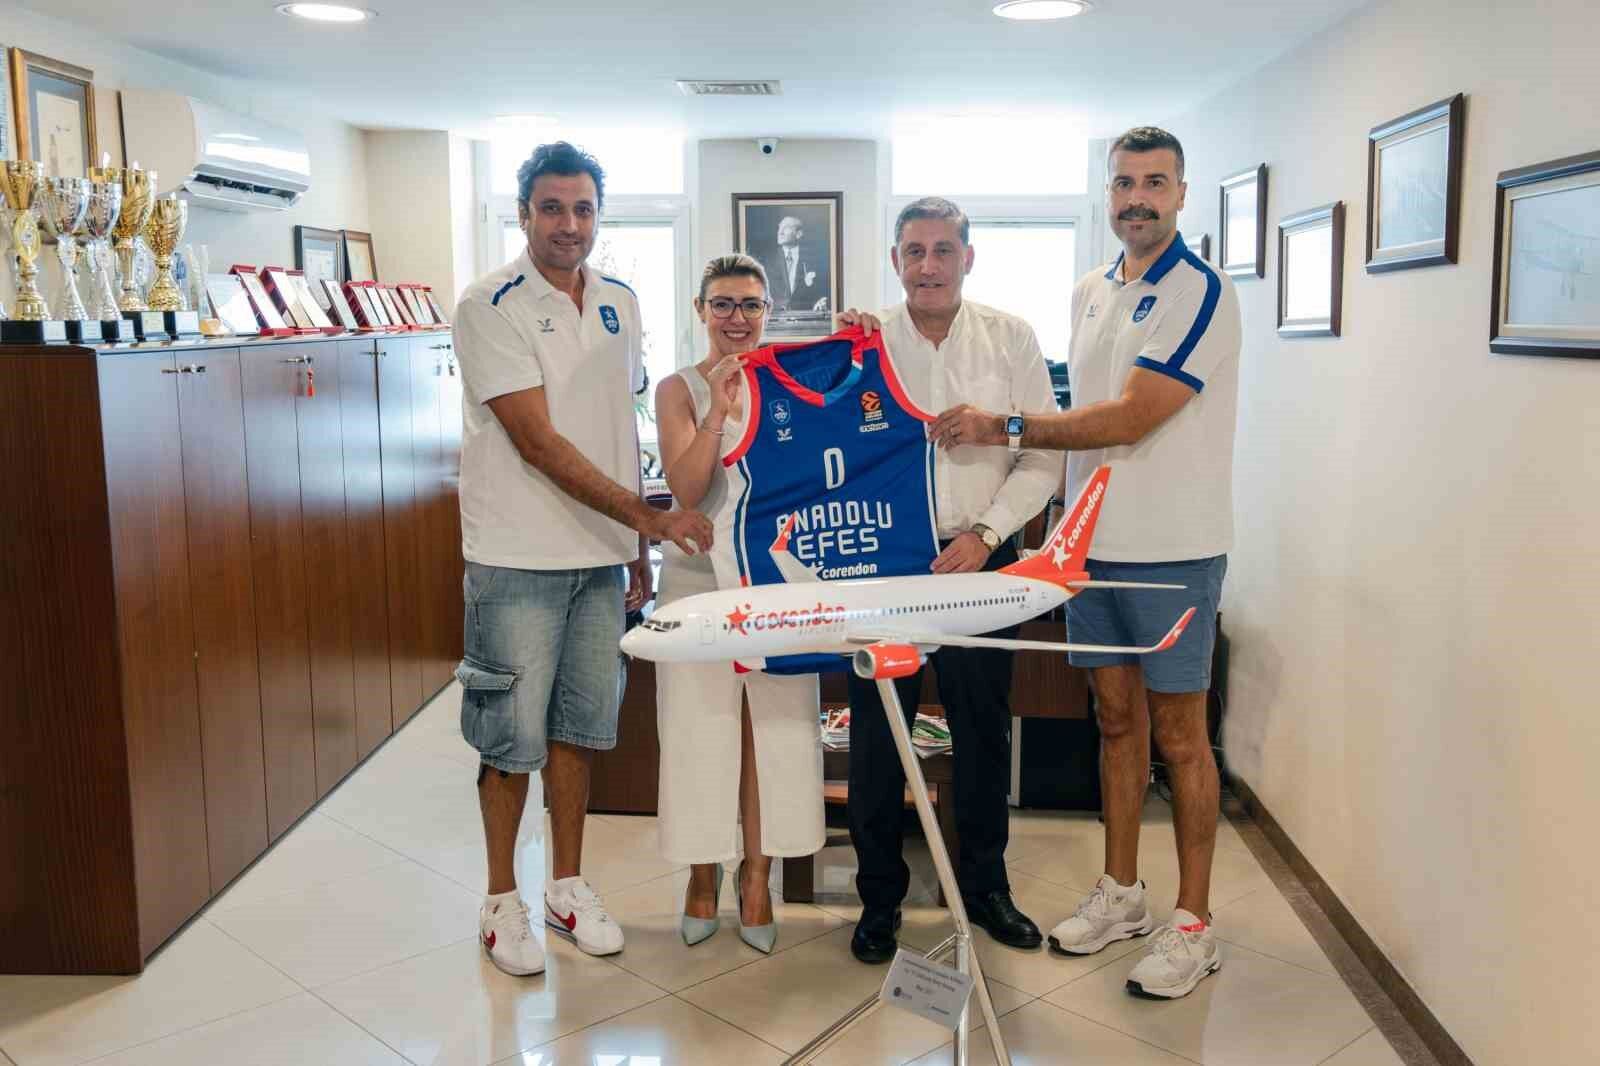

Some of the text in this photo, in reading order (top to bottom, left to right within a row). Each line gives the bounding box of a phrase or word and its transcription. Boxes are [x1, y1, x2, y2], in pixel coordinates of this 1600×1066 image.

[1067, 480, 1105, 549] corendon
[797, 527, 879, 560] EFES
[822, 562, 878, 579] corendon
[753, 601, 846, 631] corendon
